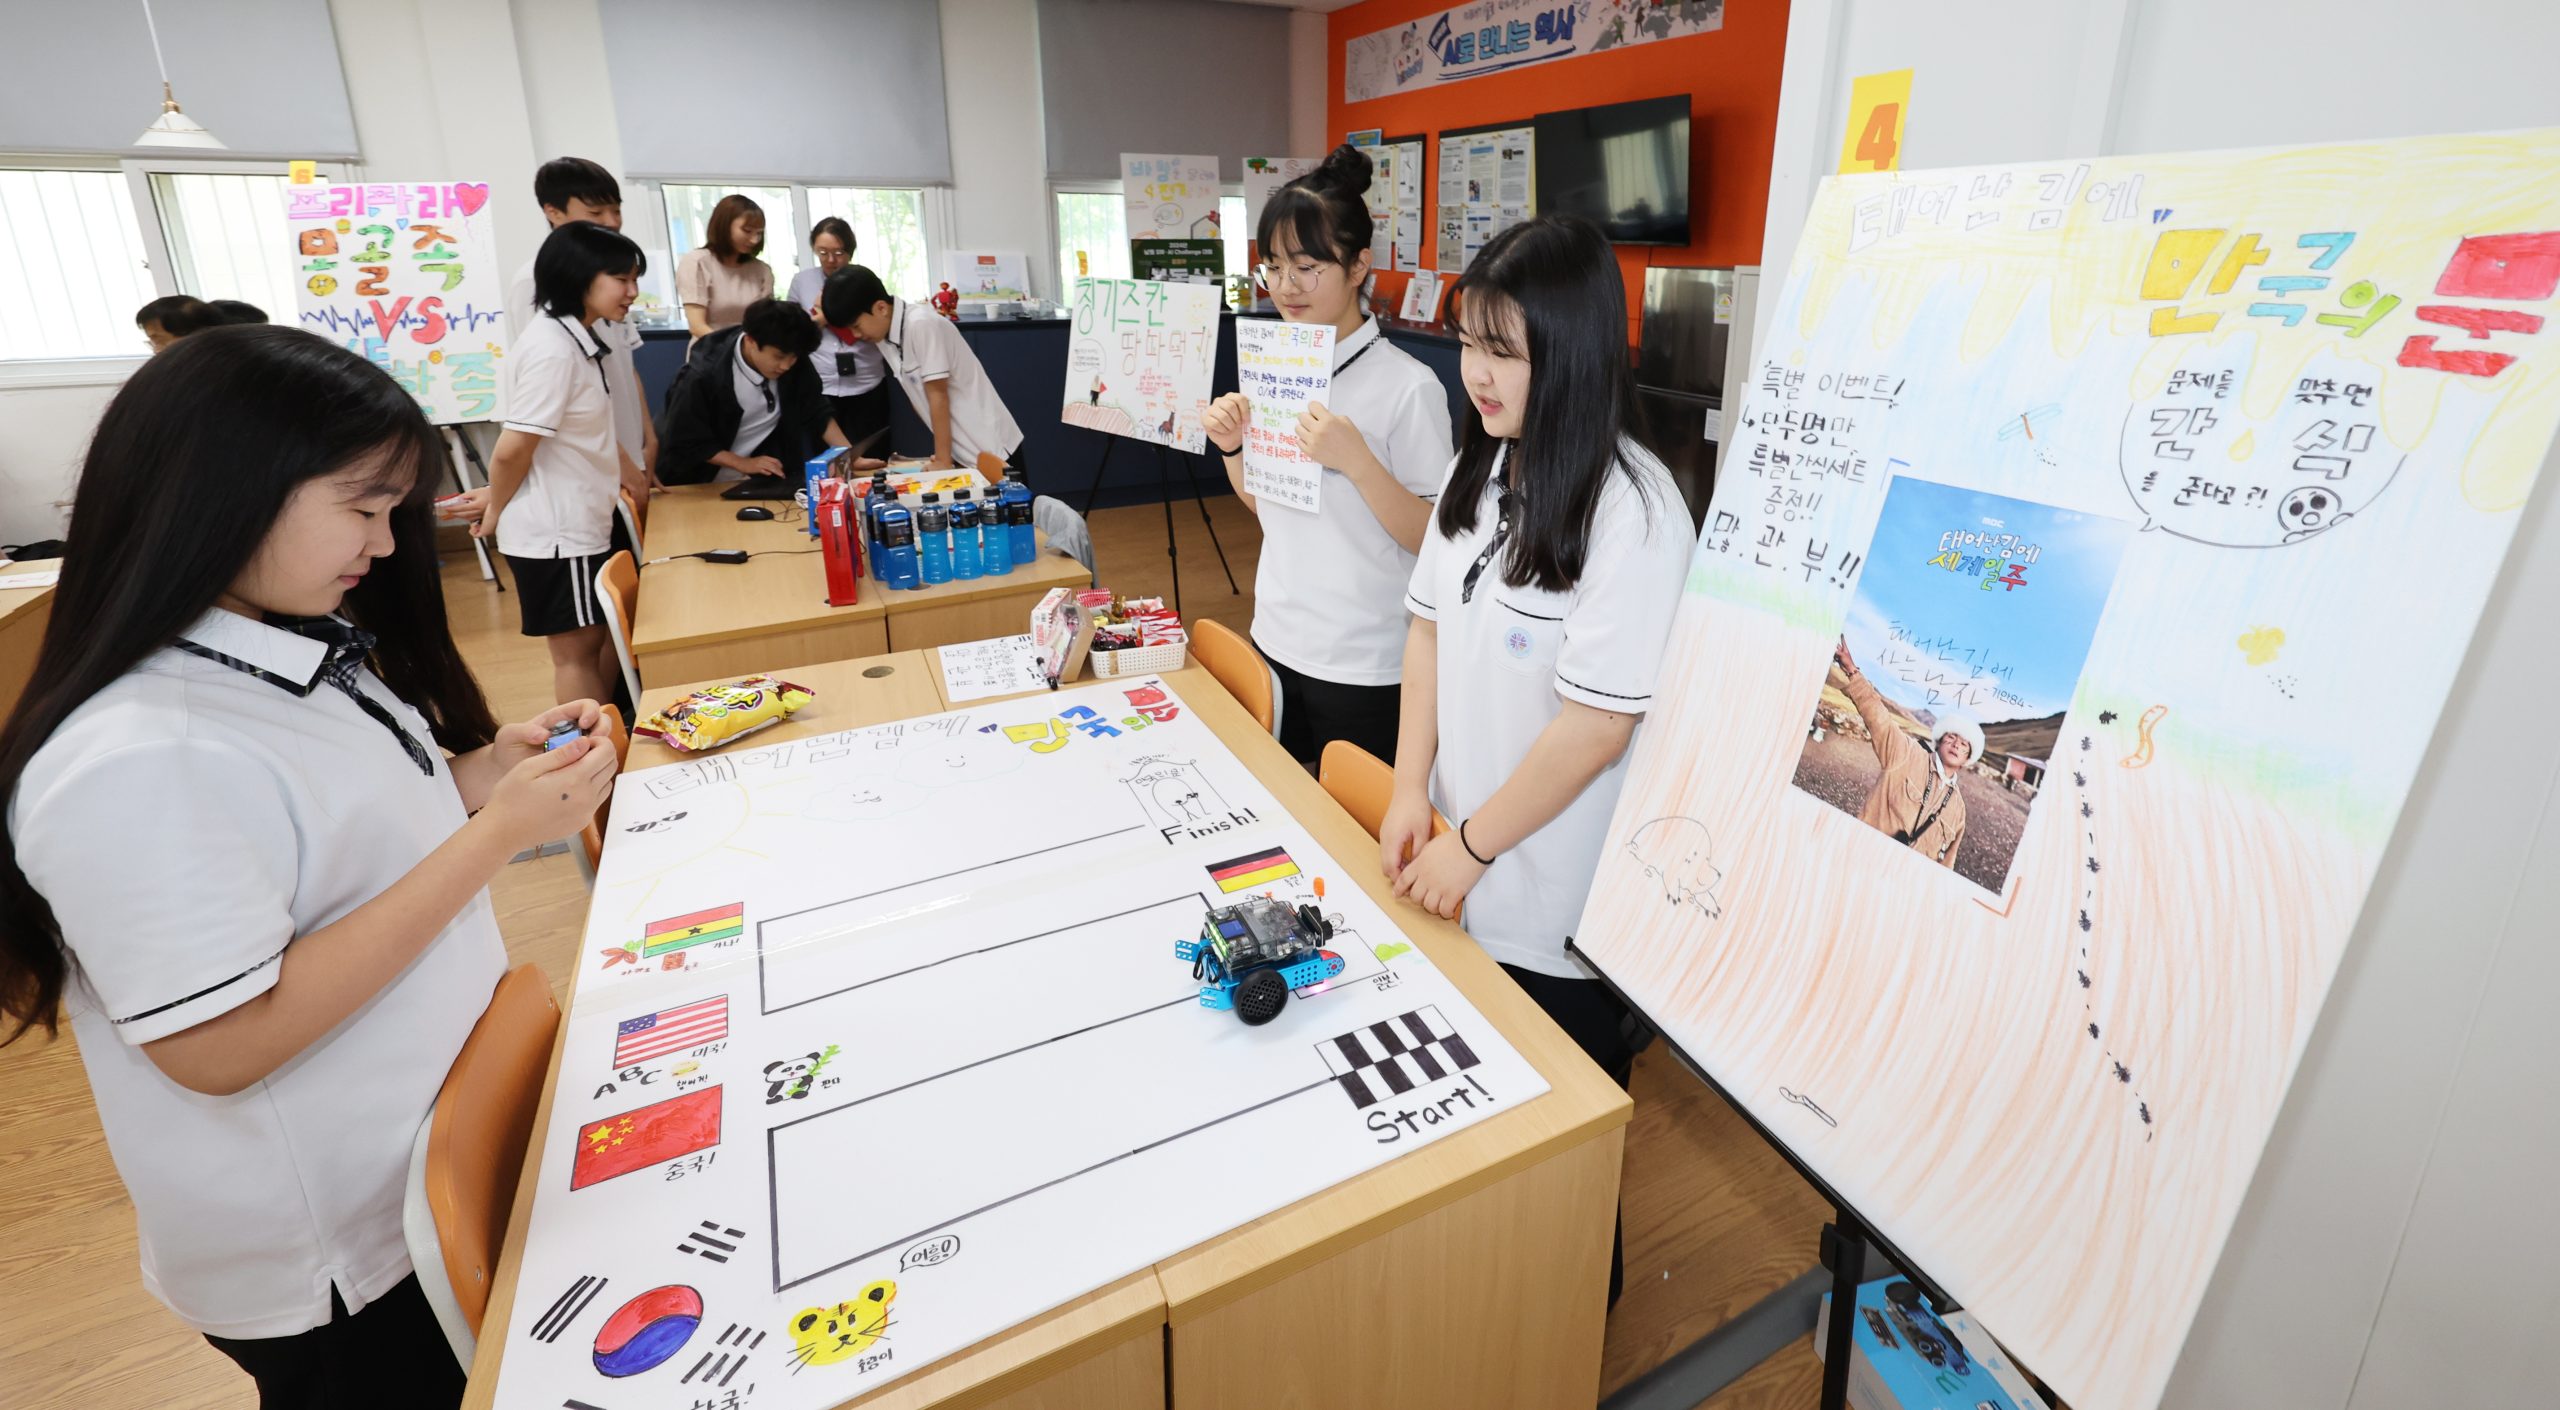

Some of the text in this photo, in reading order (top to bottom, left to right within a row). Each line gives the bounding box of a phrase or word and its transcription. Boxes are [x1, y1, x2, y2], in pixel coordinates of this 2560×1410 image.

[1479, 19, 1531, 60] 만나는
[1535, 5, 1576, 45] 역사
[1855, 102, 1899, 170] 4
[1848, 171, 2012, 254] 태어난
[2028, 164, 2144, 231] 김에
[299, 224, 464, 297] 몽골족
[368, 296, 447, 344] VS
[1762, 366, 1906, 409] 특별 이벤트!
[2167, 369, 2373, 407] 문제를 맞추면
[2150, 407, 2376, 480] 간 식
[2141, 470, 2158, 492] 를
[1763, 485, 1823, 522] 증정!!
[1926, 551, 2028, 591] 세계일주
[1888, 619, 2014, 681] 태어난 김에
[644, 731, 858, 799] 태어난
[868, 714, 971, 750] 김에
[1160, 807, 1260, 845] Finish!
[692, 1042, 728, 1058] 미국!
[593, 1065, 663, 1100] ABC
[1367, 1074, 1495, 1144] Start!
[664, 1151, 716, 1182] 중국!
[911, 1238, 952, 1264] 어흥!
[857, 1347, 894, 1375] 호랑이
